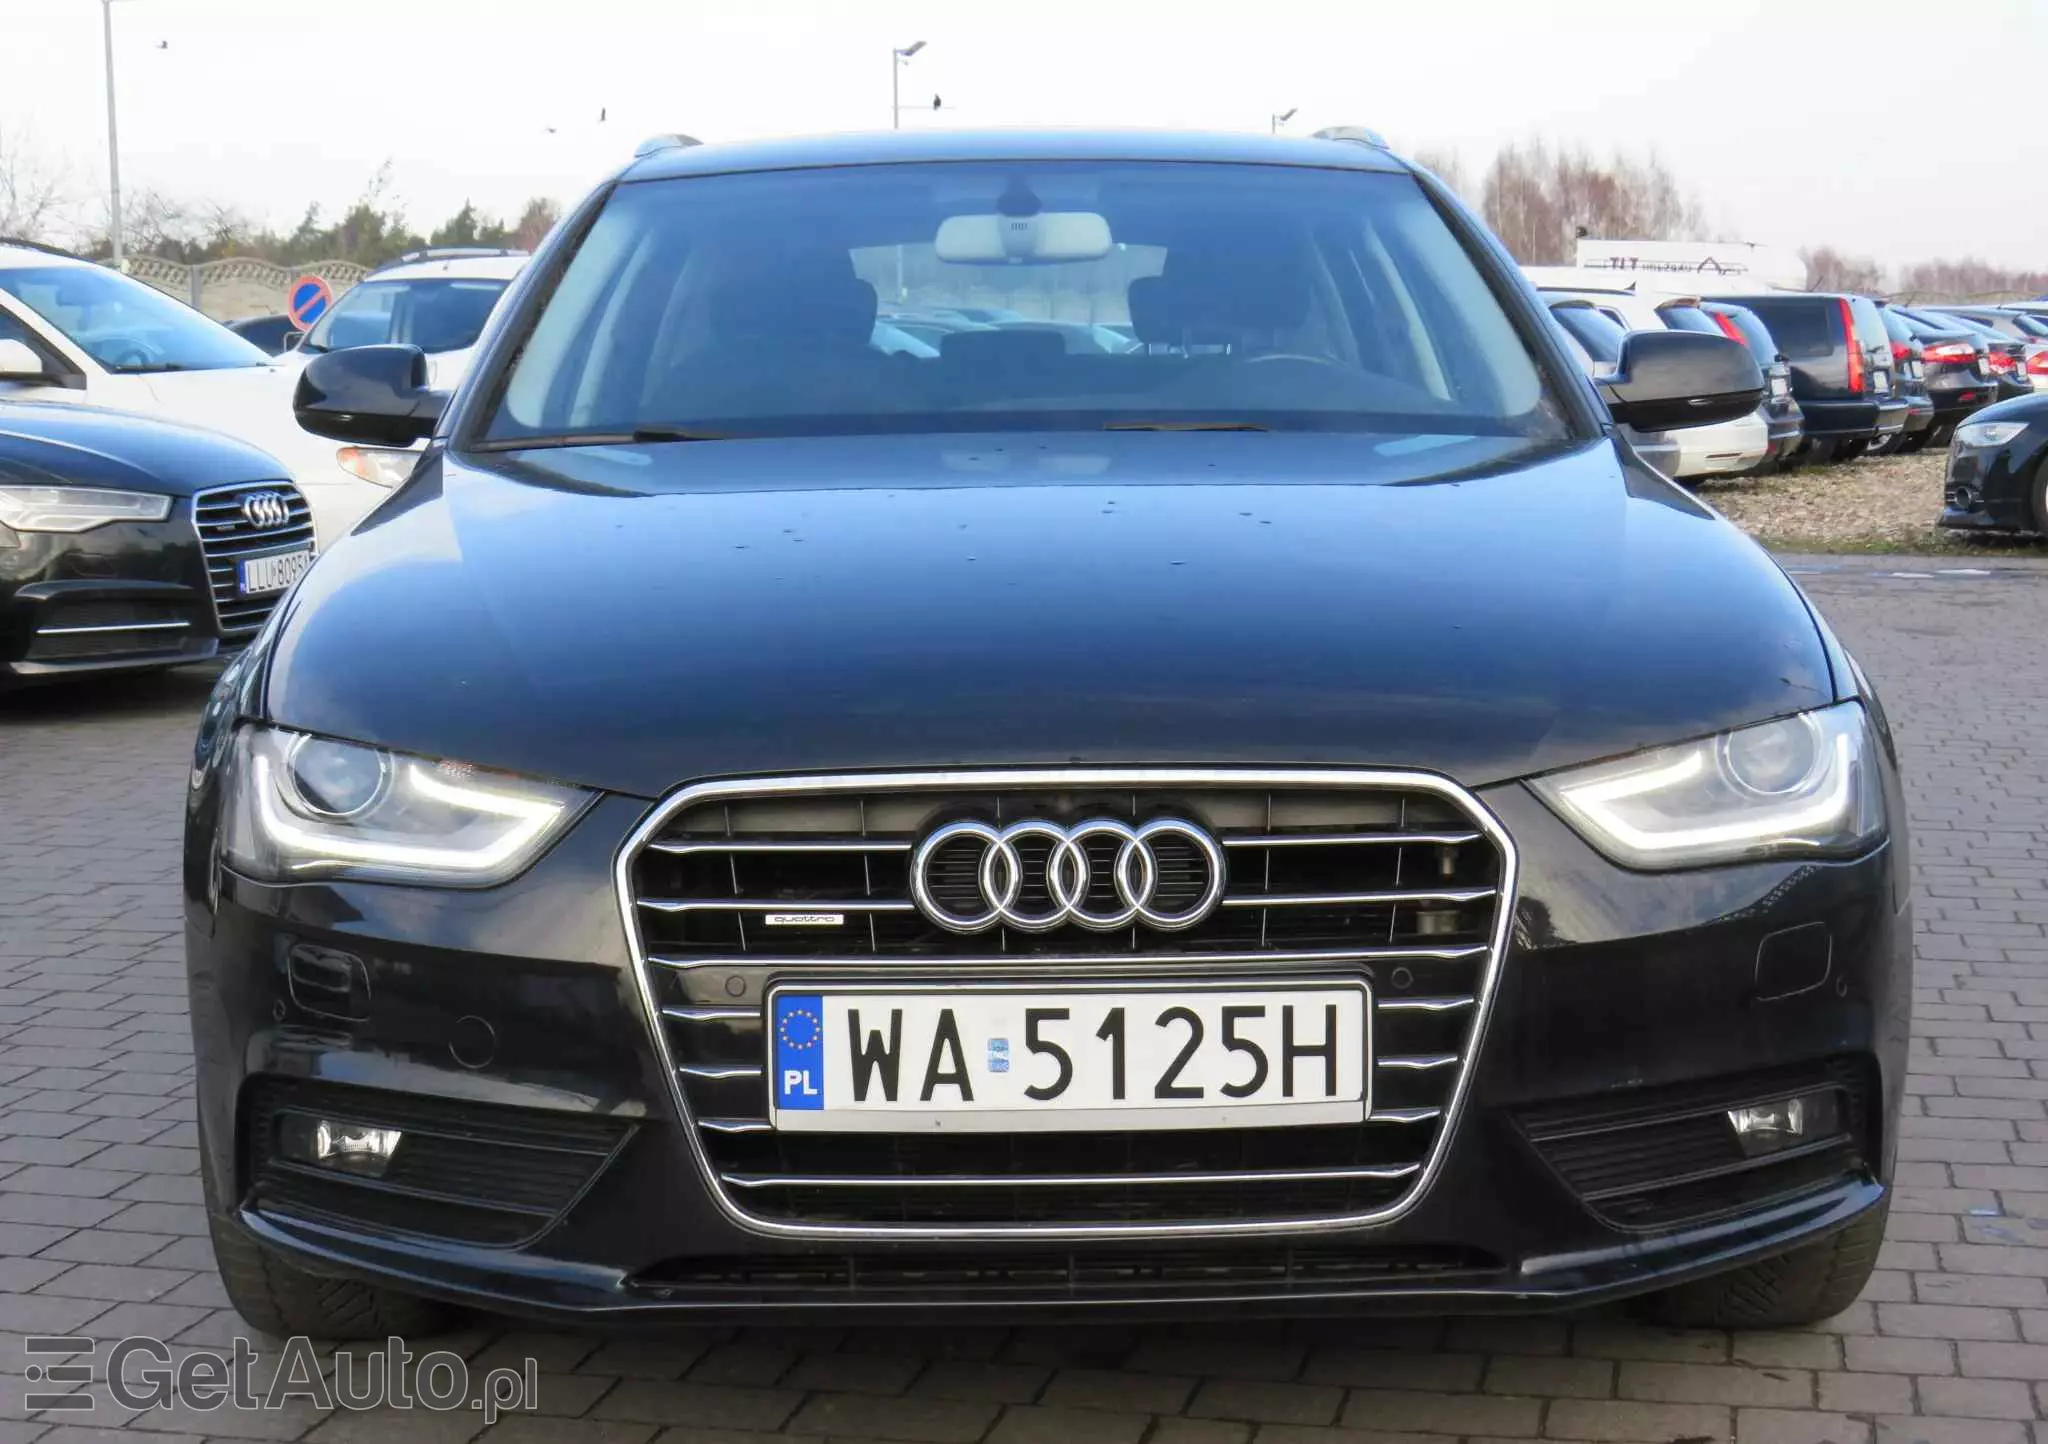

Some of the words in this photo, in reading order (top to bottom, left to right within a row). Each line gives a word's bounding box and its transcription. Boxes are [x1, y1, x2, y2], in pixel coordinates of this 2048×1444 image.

[774, 915, 835, 924] quattro
[847, 1008, 974, 1101] WA
[1023, 1004, 1337, 1101] 5125H
[783, 1069, 818, 1096] PL
